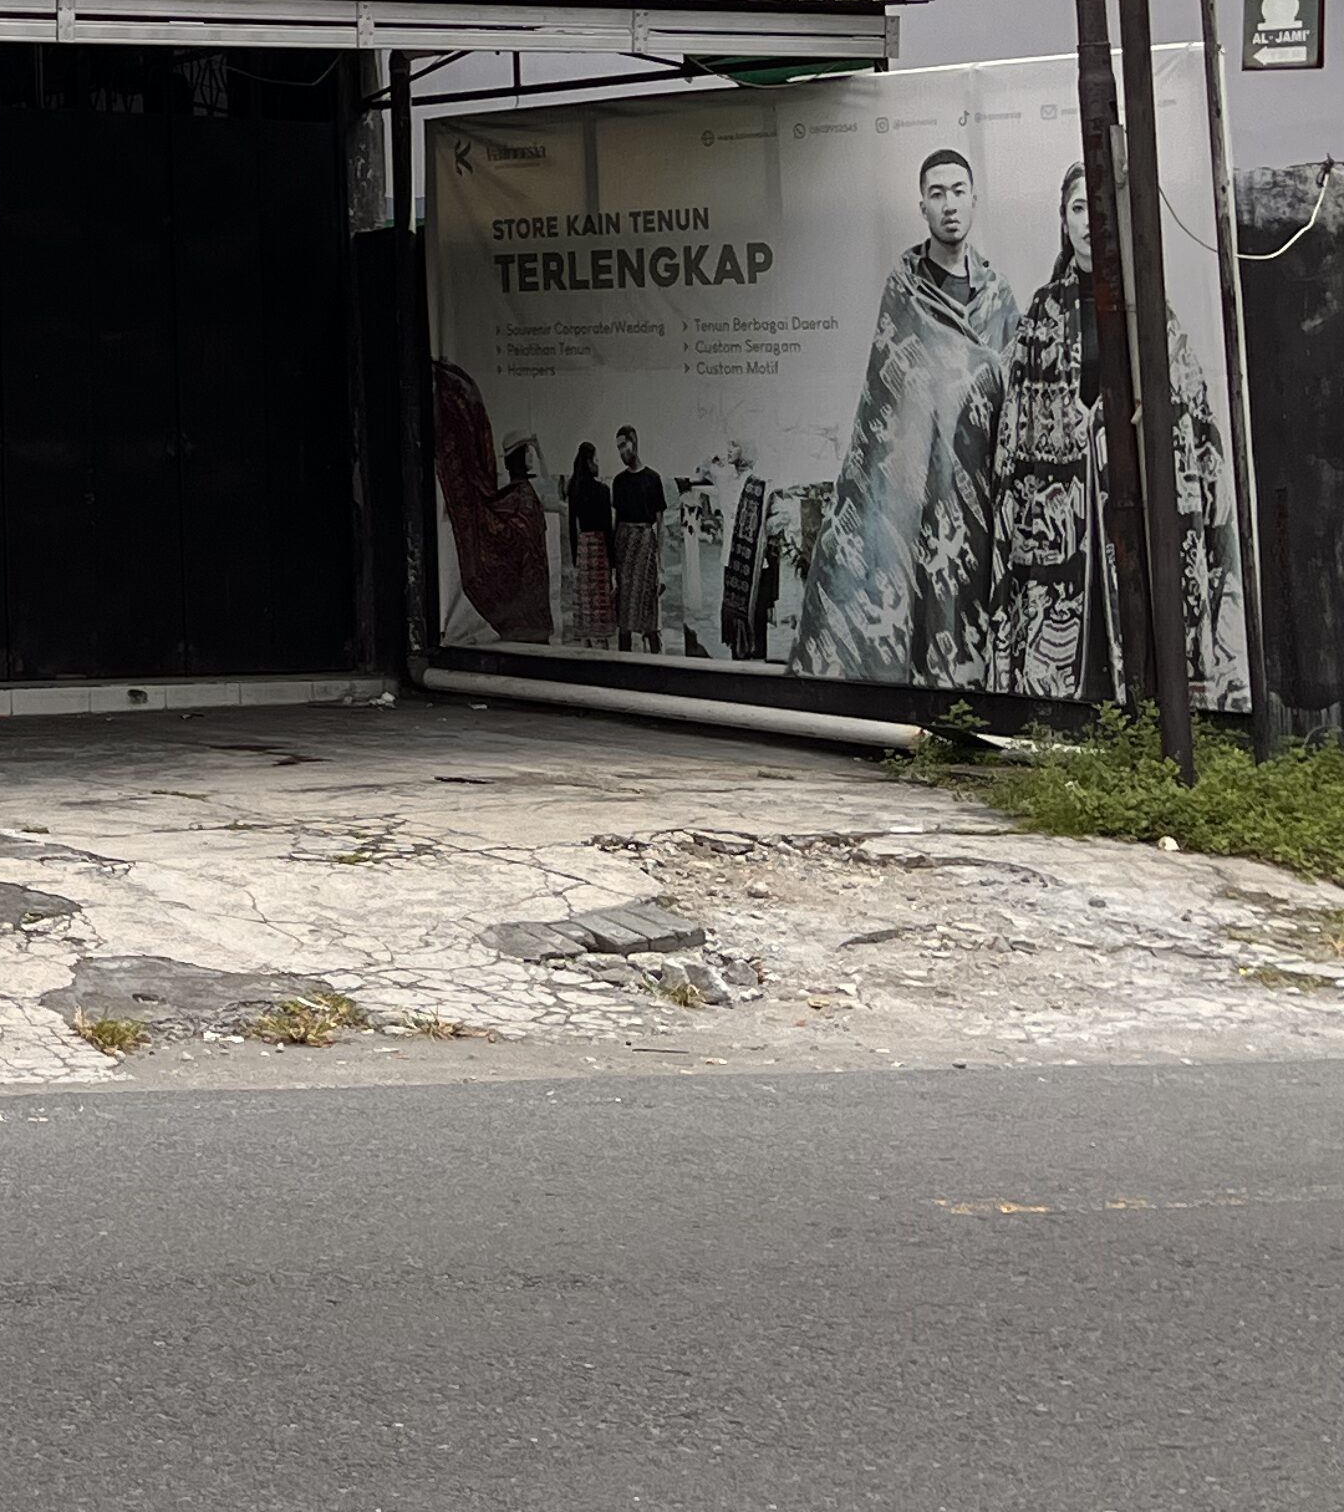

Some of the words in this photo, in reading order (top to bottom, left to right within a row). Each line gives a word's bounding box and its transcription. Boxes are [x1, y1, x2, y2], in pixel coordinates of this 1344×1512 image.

[493, 216, 558, 240] STORE
[567, 212, 620, 237] KAIN
[629, 207, 709, 233] TENUN
[494, 242, 774, 293] TERLENGKAP
[554, 320, 665, 336] Corporate/Wedding
[694, 318, 730, 332] Tenun
[733, 317, 789, 334] Berbagai
[791, 316, 839, 331] Daerah
[559, 342, 591, 355] Tenun
[695, 340, 742, 353] Custom
[744, 339, 801, 356] Seragam
[507, 364, 556, 377] Hampers
[696, 361, 743, 375] Custom
[746, 360, 779, 375] Motif
